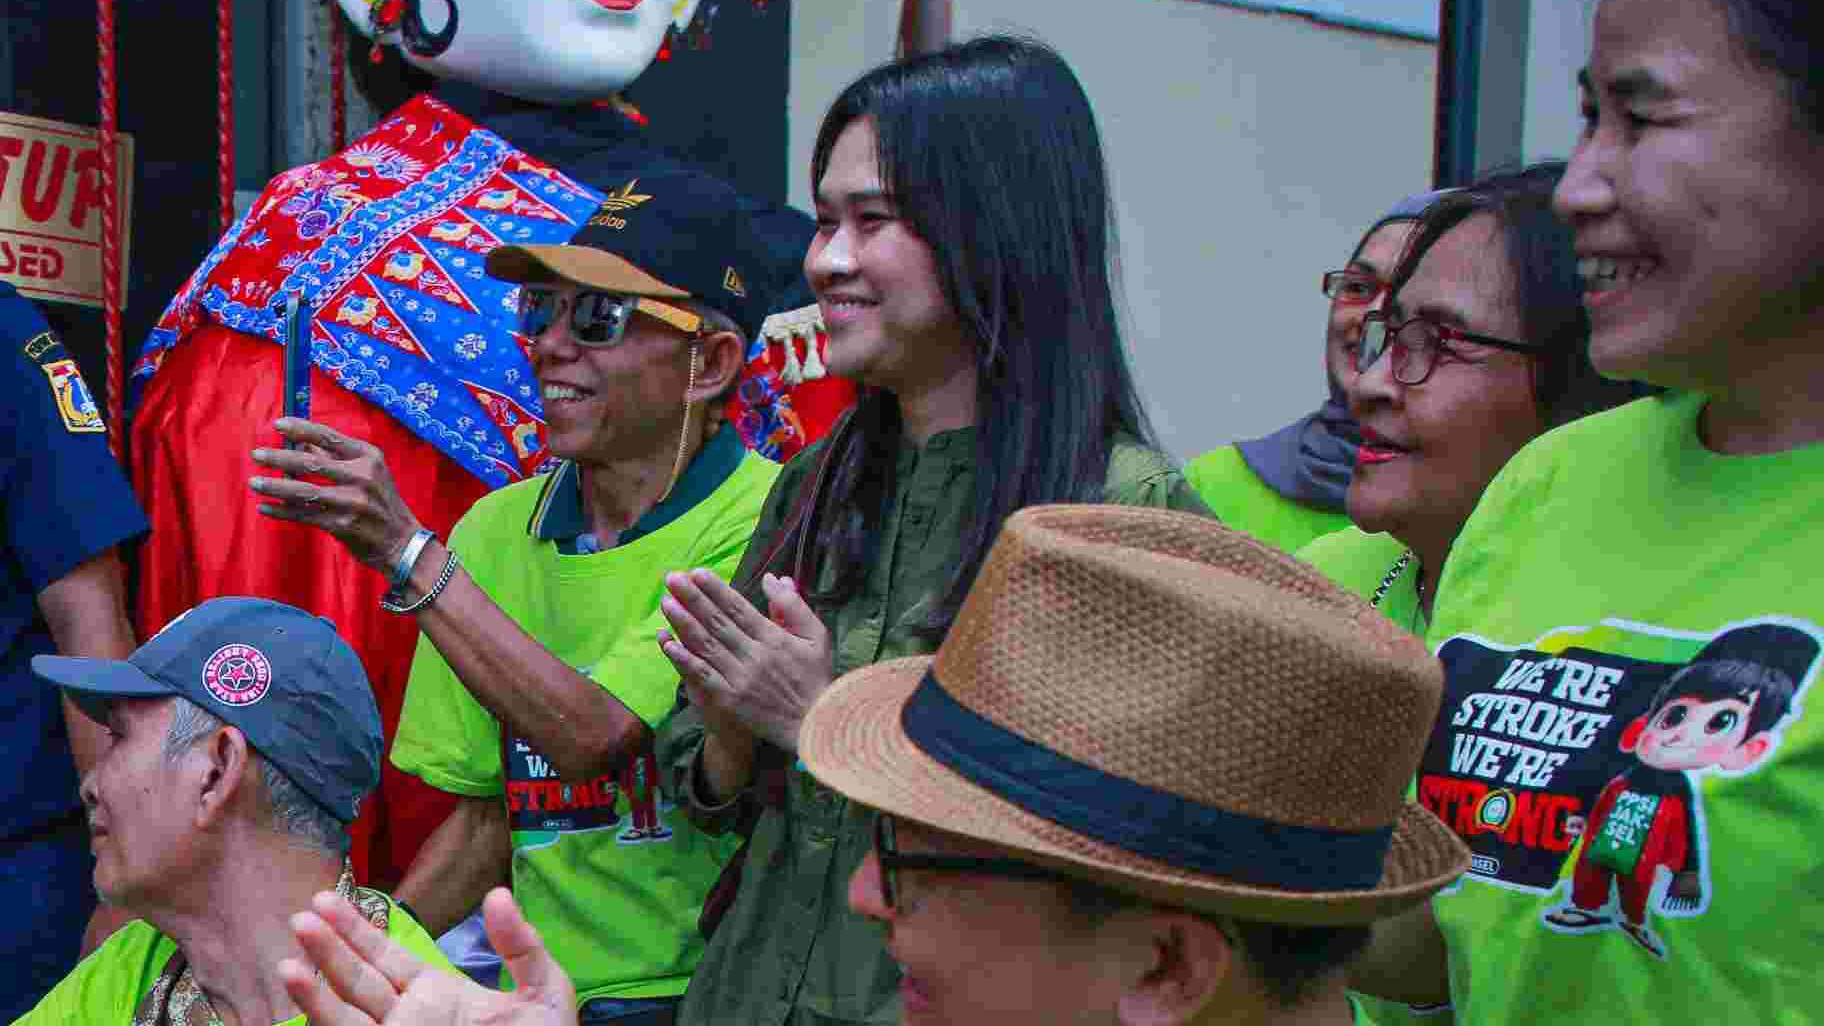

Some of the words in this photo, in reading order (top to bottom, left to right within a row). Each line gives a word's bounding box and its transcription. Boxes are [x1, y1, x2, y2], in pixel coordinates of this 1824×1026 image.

[1494, 658, 1625, 707] WE'RE
[1453, 692, 1613, 748] STROKE
[1449, 733, 1571, 787] WE'RE
